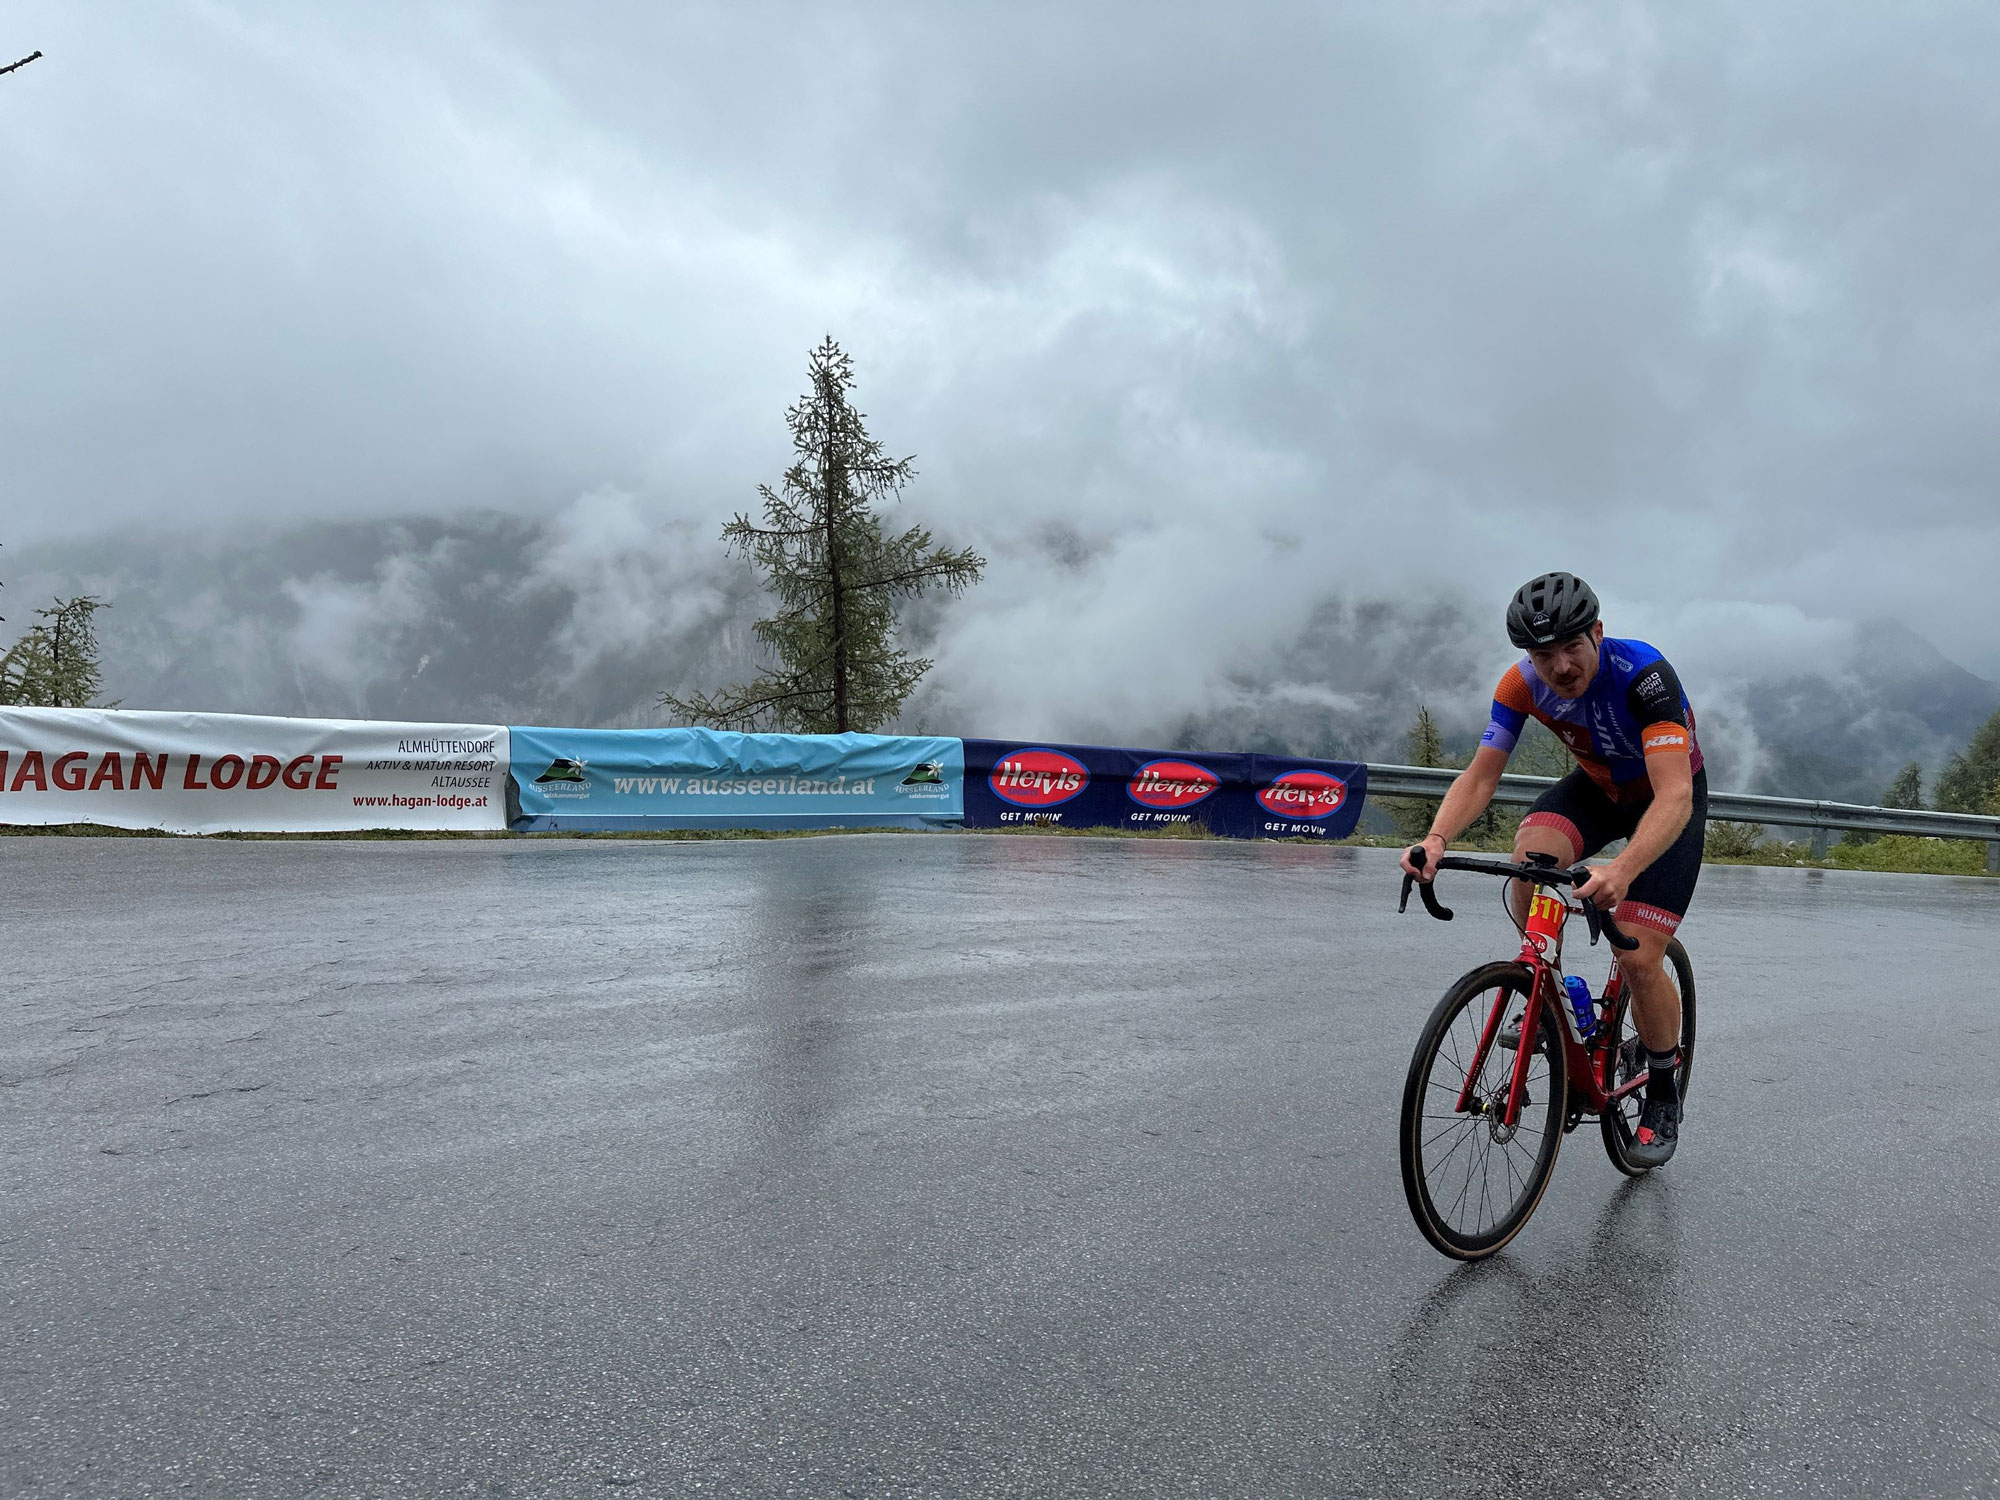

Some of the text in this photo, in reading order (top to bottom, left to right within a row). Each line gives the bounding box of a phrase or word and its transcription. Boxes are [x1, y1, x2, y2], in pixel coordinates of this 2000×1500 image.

[1640, 678, 1663, 697] SPORT
[398, 738, 495, 754] ALMHÜTTENDORF
[0, 750, 343, 791] AGAN LODGE
[365, 760, 496, 772] AKTIV & NATUR RESORT
[431, 775, 491, 788] ALTAUSSEE
[613, 775, 875, 796] www.ausseerland.at
[999, 761, 1081, 795] Hervis
[1136, 769, 1213, 798] Hervis
[528, 782, 592, 793] AUSSEERLAND
[893, 783, 950, 794] AUSSEERLAND
[352, 793, 489, 810] www.hagan-lodge.at
[1000, 812, 1021, 821] GET
[1130, 813, 1152, 821] GET
[1264, 822, 1288, 831] GET
[1637, 908, 1680, 929] HUMANP
